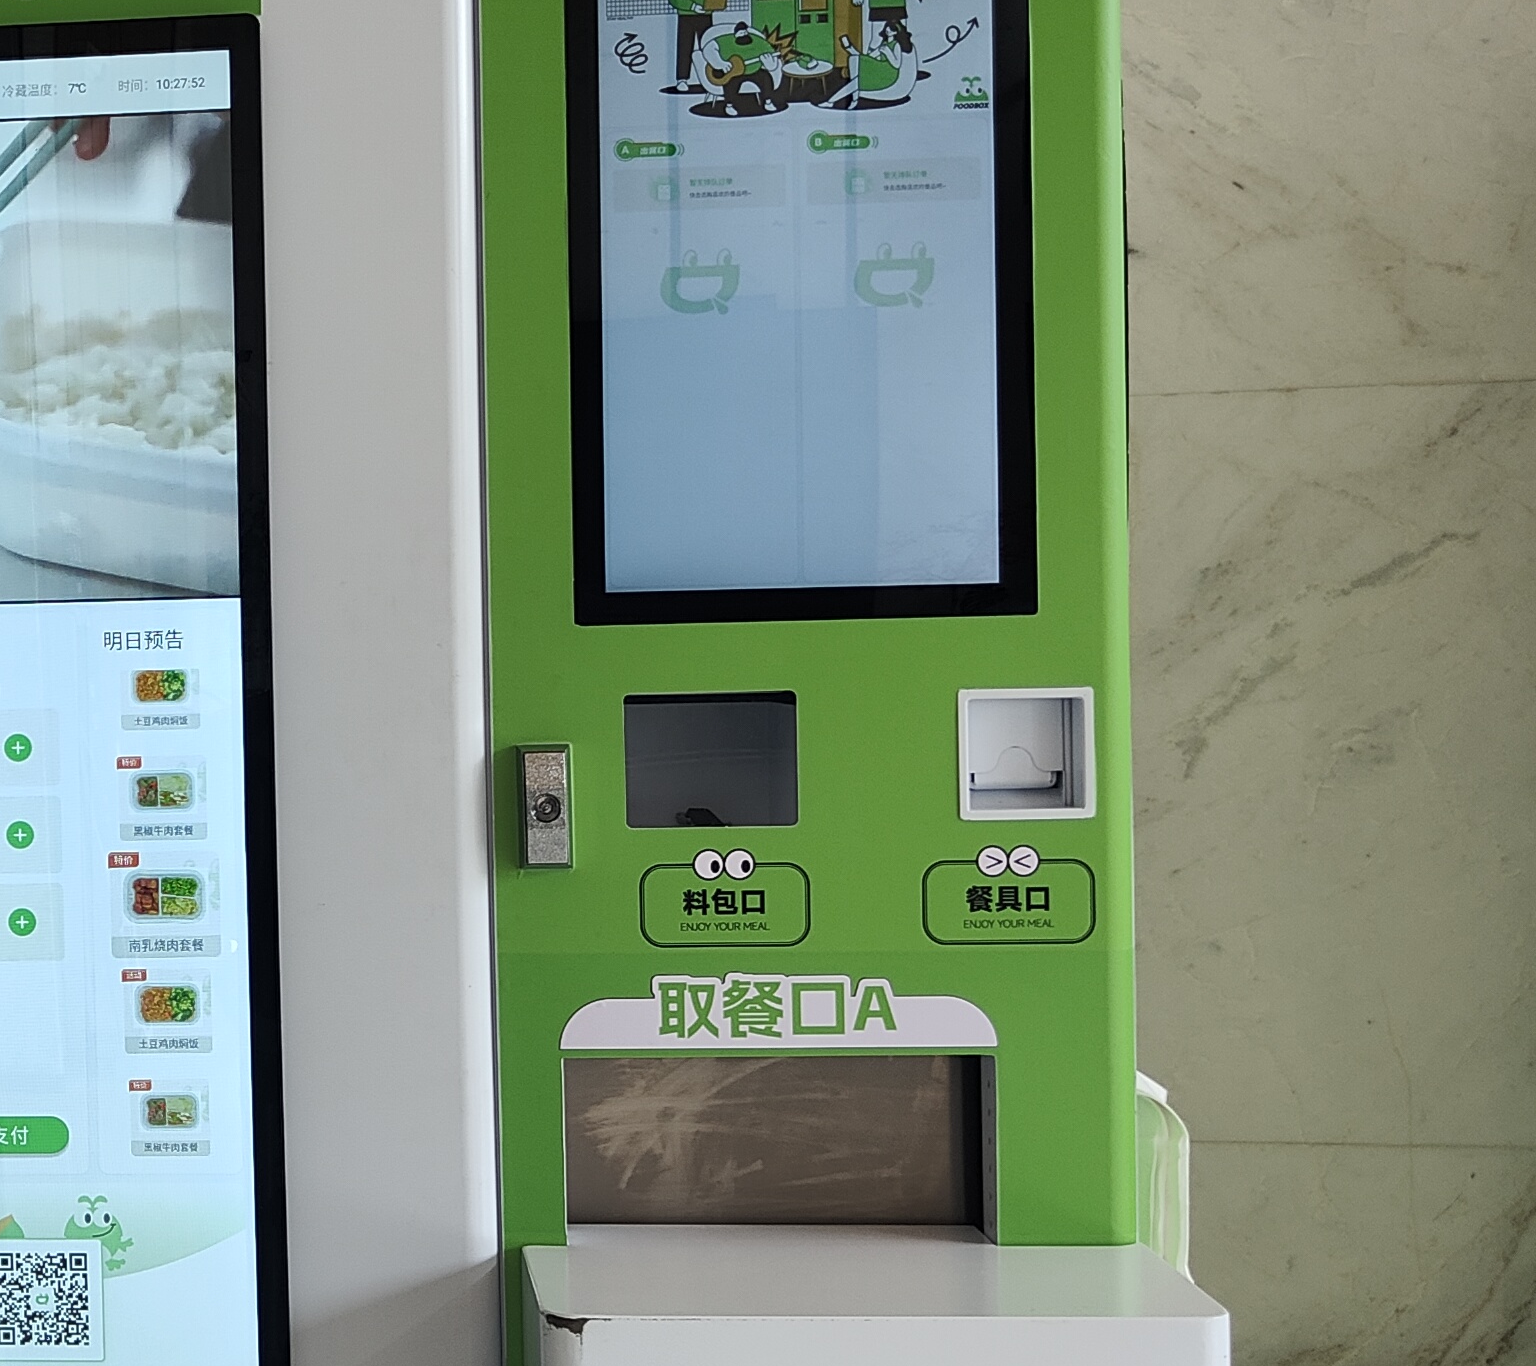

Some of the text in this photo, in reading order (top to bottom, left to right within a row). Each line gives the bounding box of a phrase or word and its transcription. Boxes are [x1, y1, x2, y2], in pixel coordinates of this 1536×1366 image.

[156, 77, 206, 90] 10:27:52
[621, 146, 629, 154] A
[103, 629, 184, 651] 明日预告
[133, 825, 194, 836] 黑椒牛肉套餐
[682, 889, 766, 916] 料包口
[966, 885, 1050, 913] 餐具口
[680, 921, 770, 932] ENJOY YOUR MEAL
[964, 918, 1055, 929] ENJOY YOUR MEAL
[129, 938, 204, 953] 南乳烧肉套餐
[658, 979, 897, 1039] 取餐口A
[138, 1039, 199, 1049] 土豆鸡肉焖饭
[144, 1143, 198, 1153] 黑椒牛肉套餐
